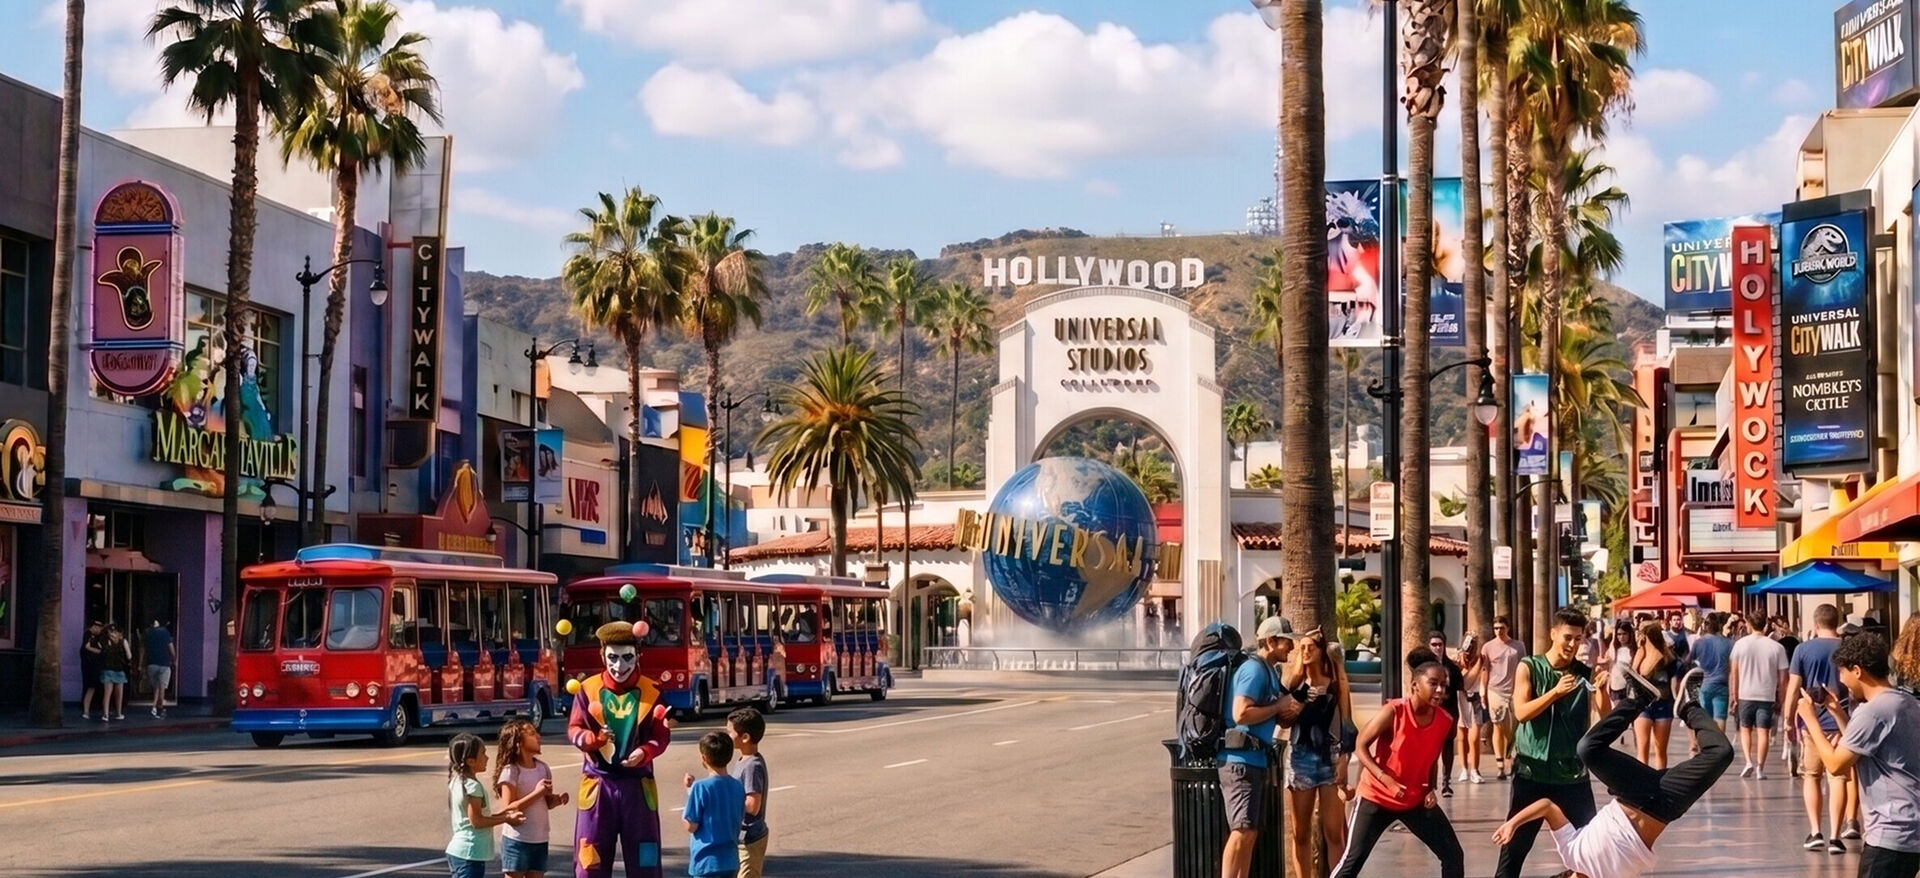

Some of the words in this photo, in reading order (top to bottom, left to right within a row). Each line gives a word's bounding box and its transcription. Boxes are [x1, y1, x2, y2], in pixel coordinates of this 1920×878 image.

[984, 255, 1205, 289] HOLLYWOOD
[413, 244, 434, 410] CITYWALK
[1054, 316, 1161, 342] UNIVERSAL
[1791, 307, 1860, 325] UNIVERSAL
[1790, 320, 1862, 356] CITYWALK
[1067, 347, 1148, 372] STUDIOS
[153, 411, 298, 480] MARGATAVILLE
[973, 512, 1144, 574] UNIVERSAL
